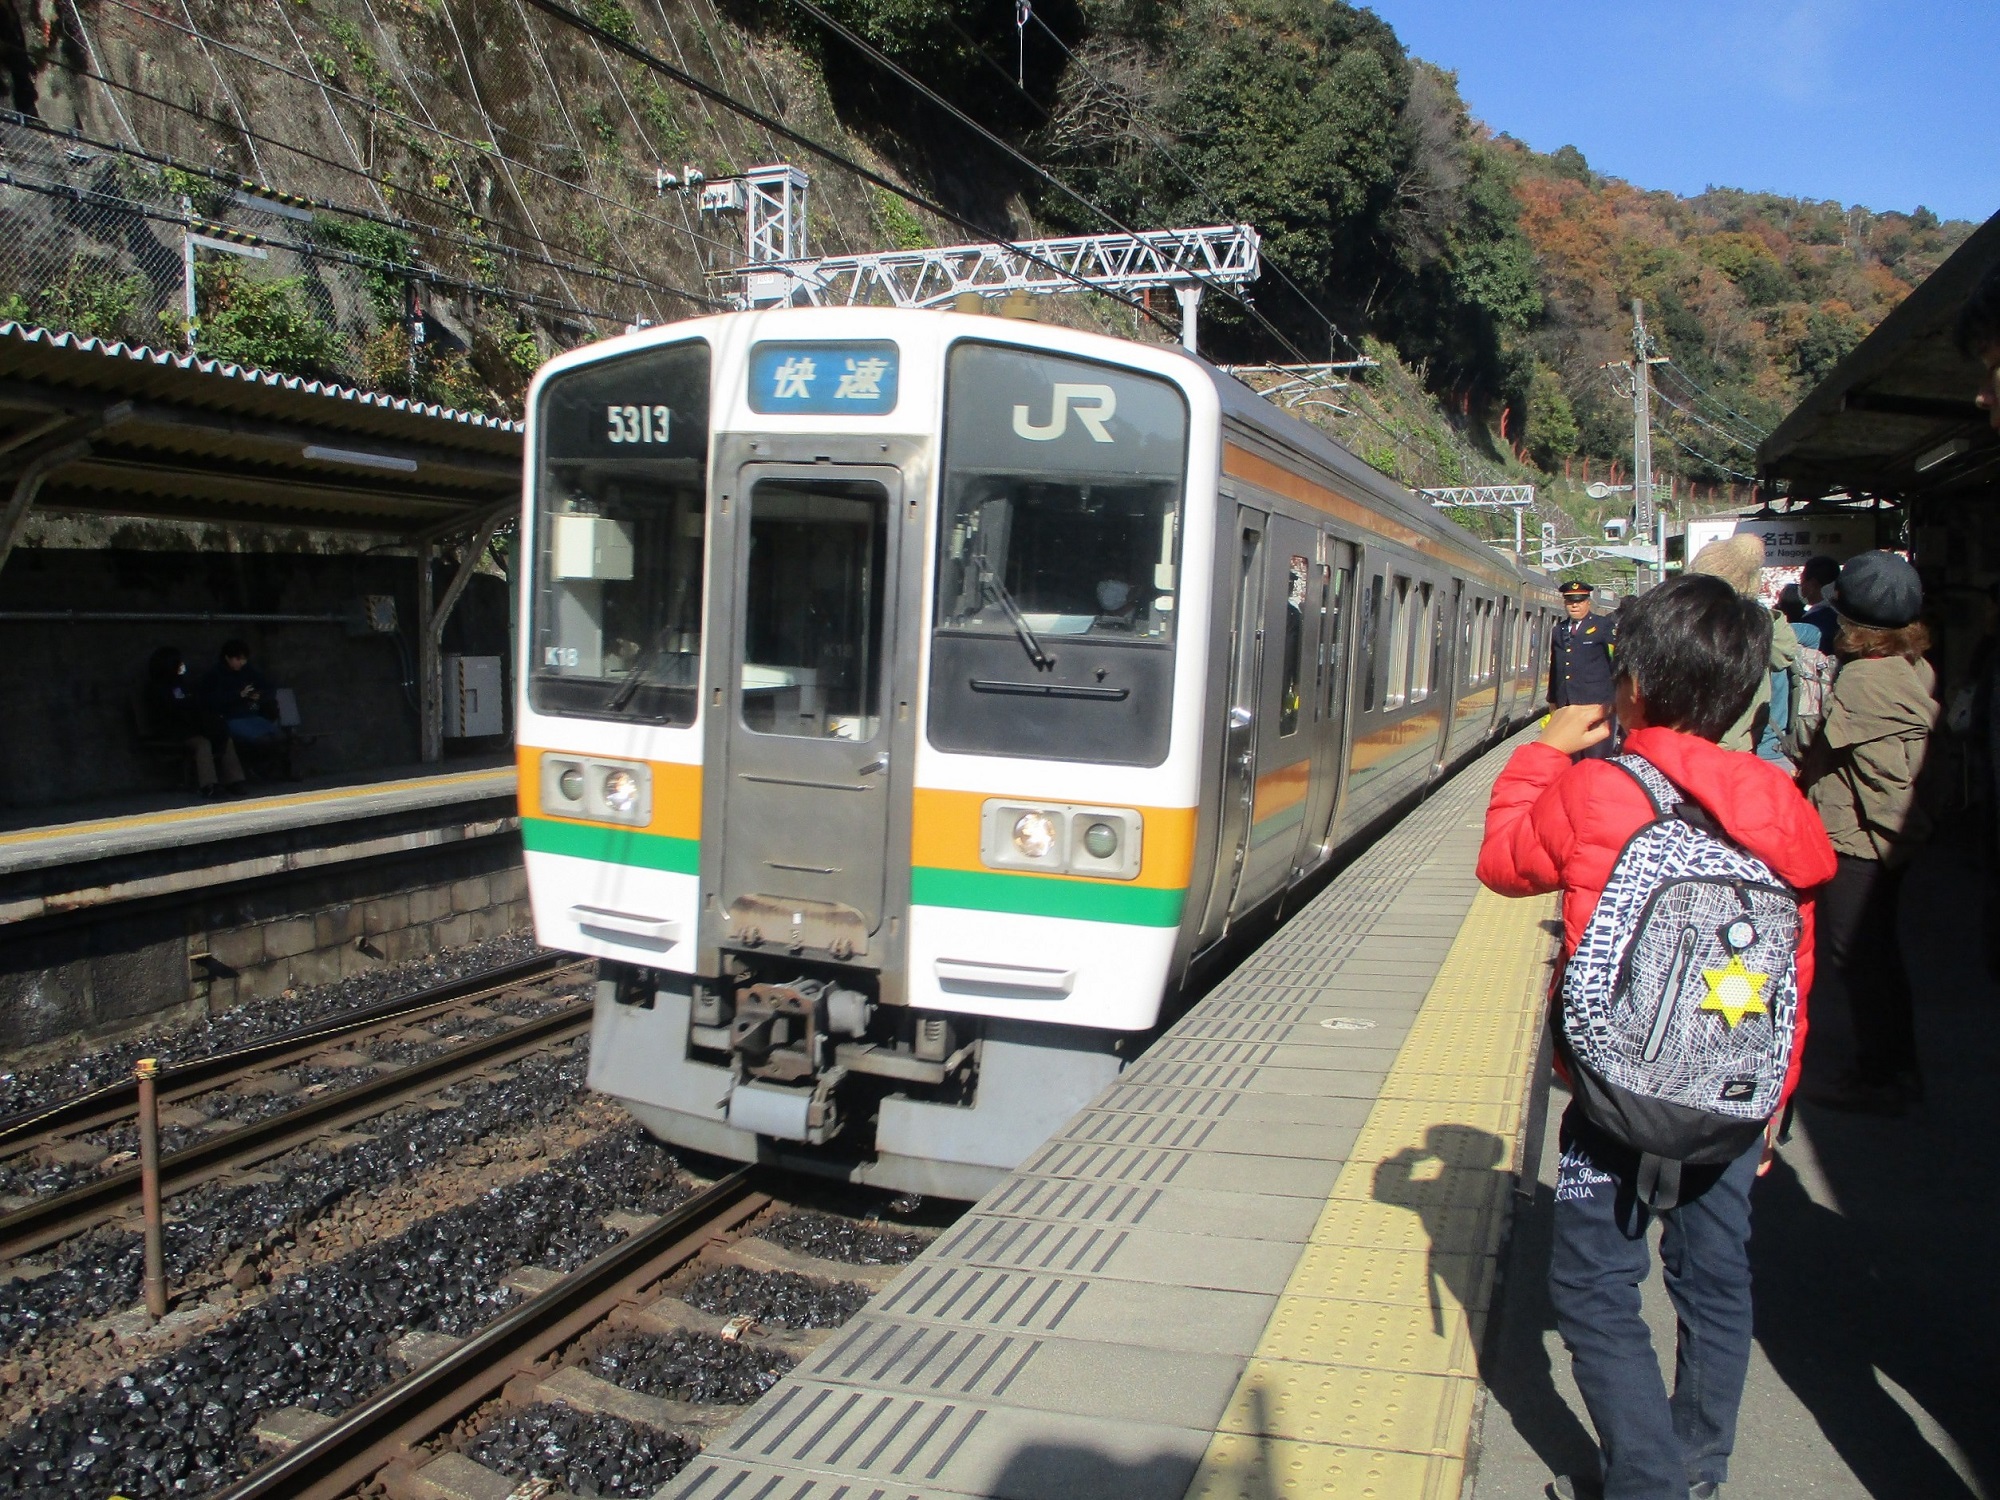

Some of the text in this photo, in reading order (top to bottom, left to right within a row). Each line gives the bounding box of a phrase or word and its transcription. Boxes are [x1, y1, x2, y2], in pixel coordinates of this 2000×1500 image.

[773, 357, 889, 400] 快速
[608, 405, 670, 443] 5313
[1012, 383, 1117, 442] JR
[1762, 532, 1810, 546] 名古屋
[1777, 549, 1812, 558] Nagoya
[1598, 873, 1623, 919] NIKE
[1590, 925, 1613, 972] NIKE
[1584, 974, 1604, 1019] NIKE
